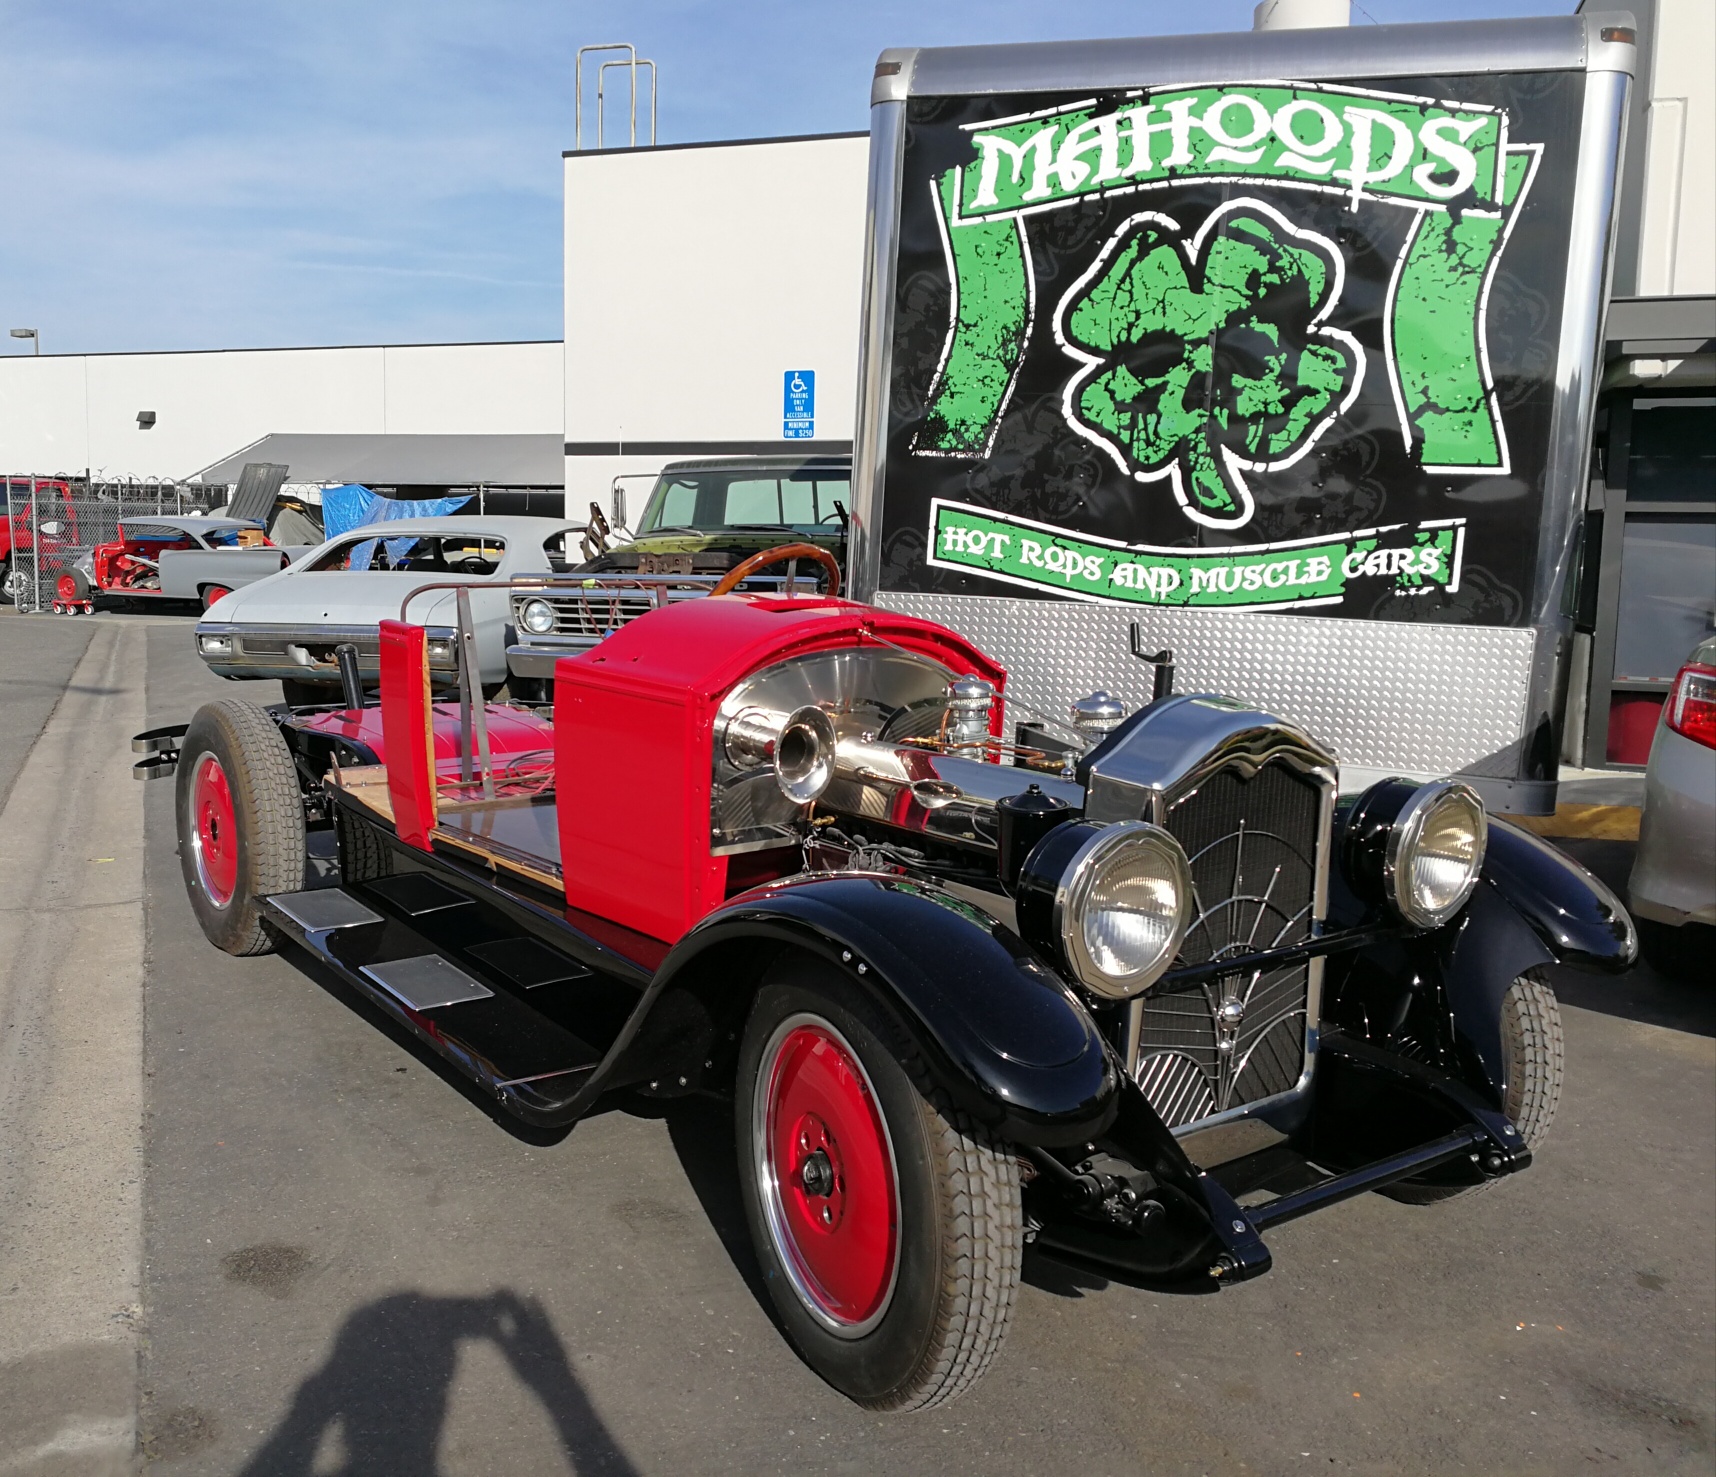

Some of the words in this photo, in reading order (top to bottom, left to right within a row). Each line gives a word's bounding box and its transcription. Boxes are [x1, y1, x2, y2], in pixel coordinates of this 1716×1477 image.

[969, 93, 1489, 213] MAHOODS
[788, 421, 810, 429] MINIMUM
[798, 429, 813, 437] $250
[943, 525, 1011, 560] HOT
[1019, 544, 1103, 583] RODS
[1109, 562, 1181, 599] AND
[1188, 555, 1331, 593] MUSCLE
[1341, 546, 1444, 579] CARS
